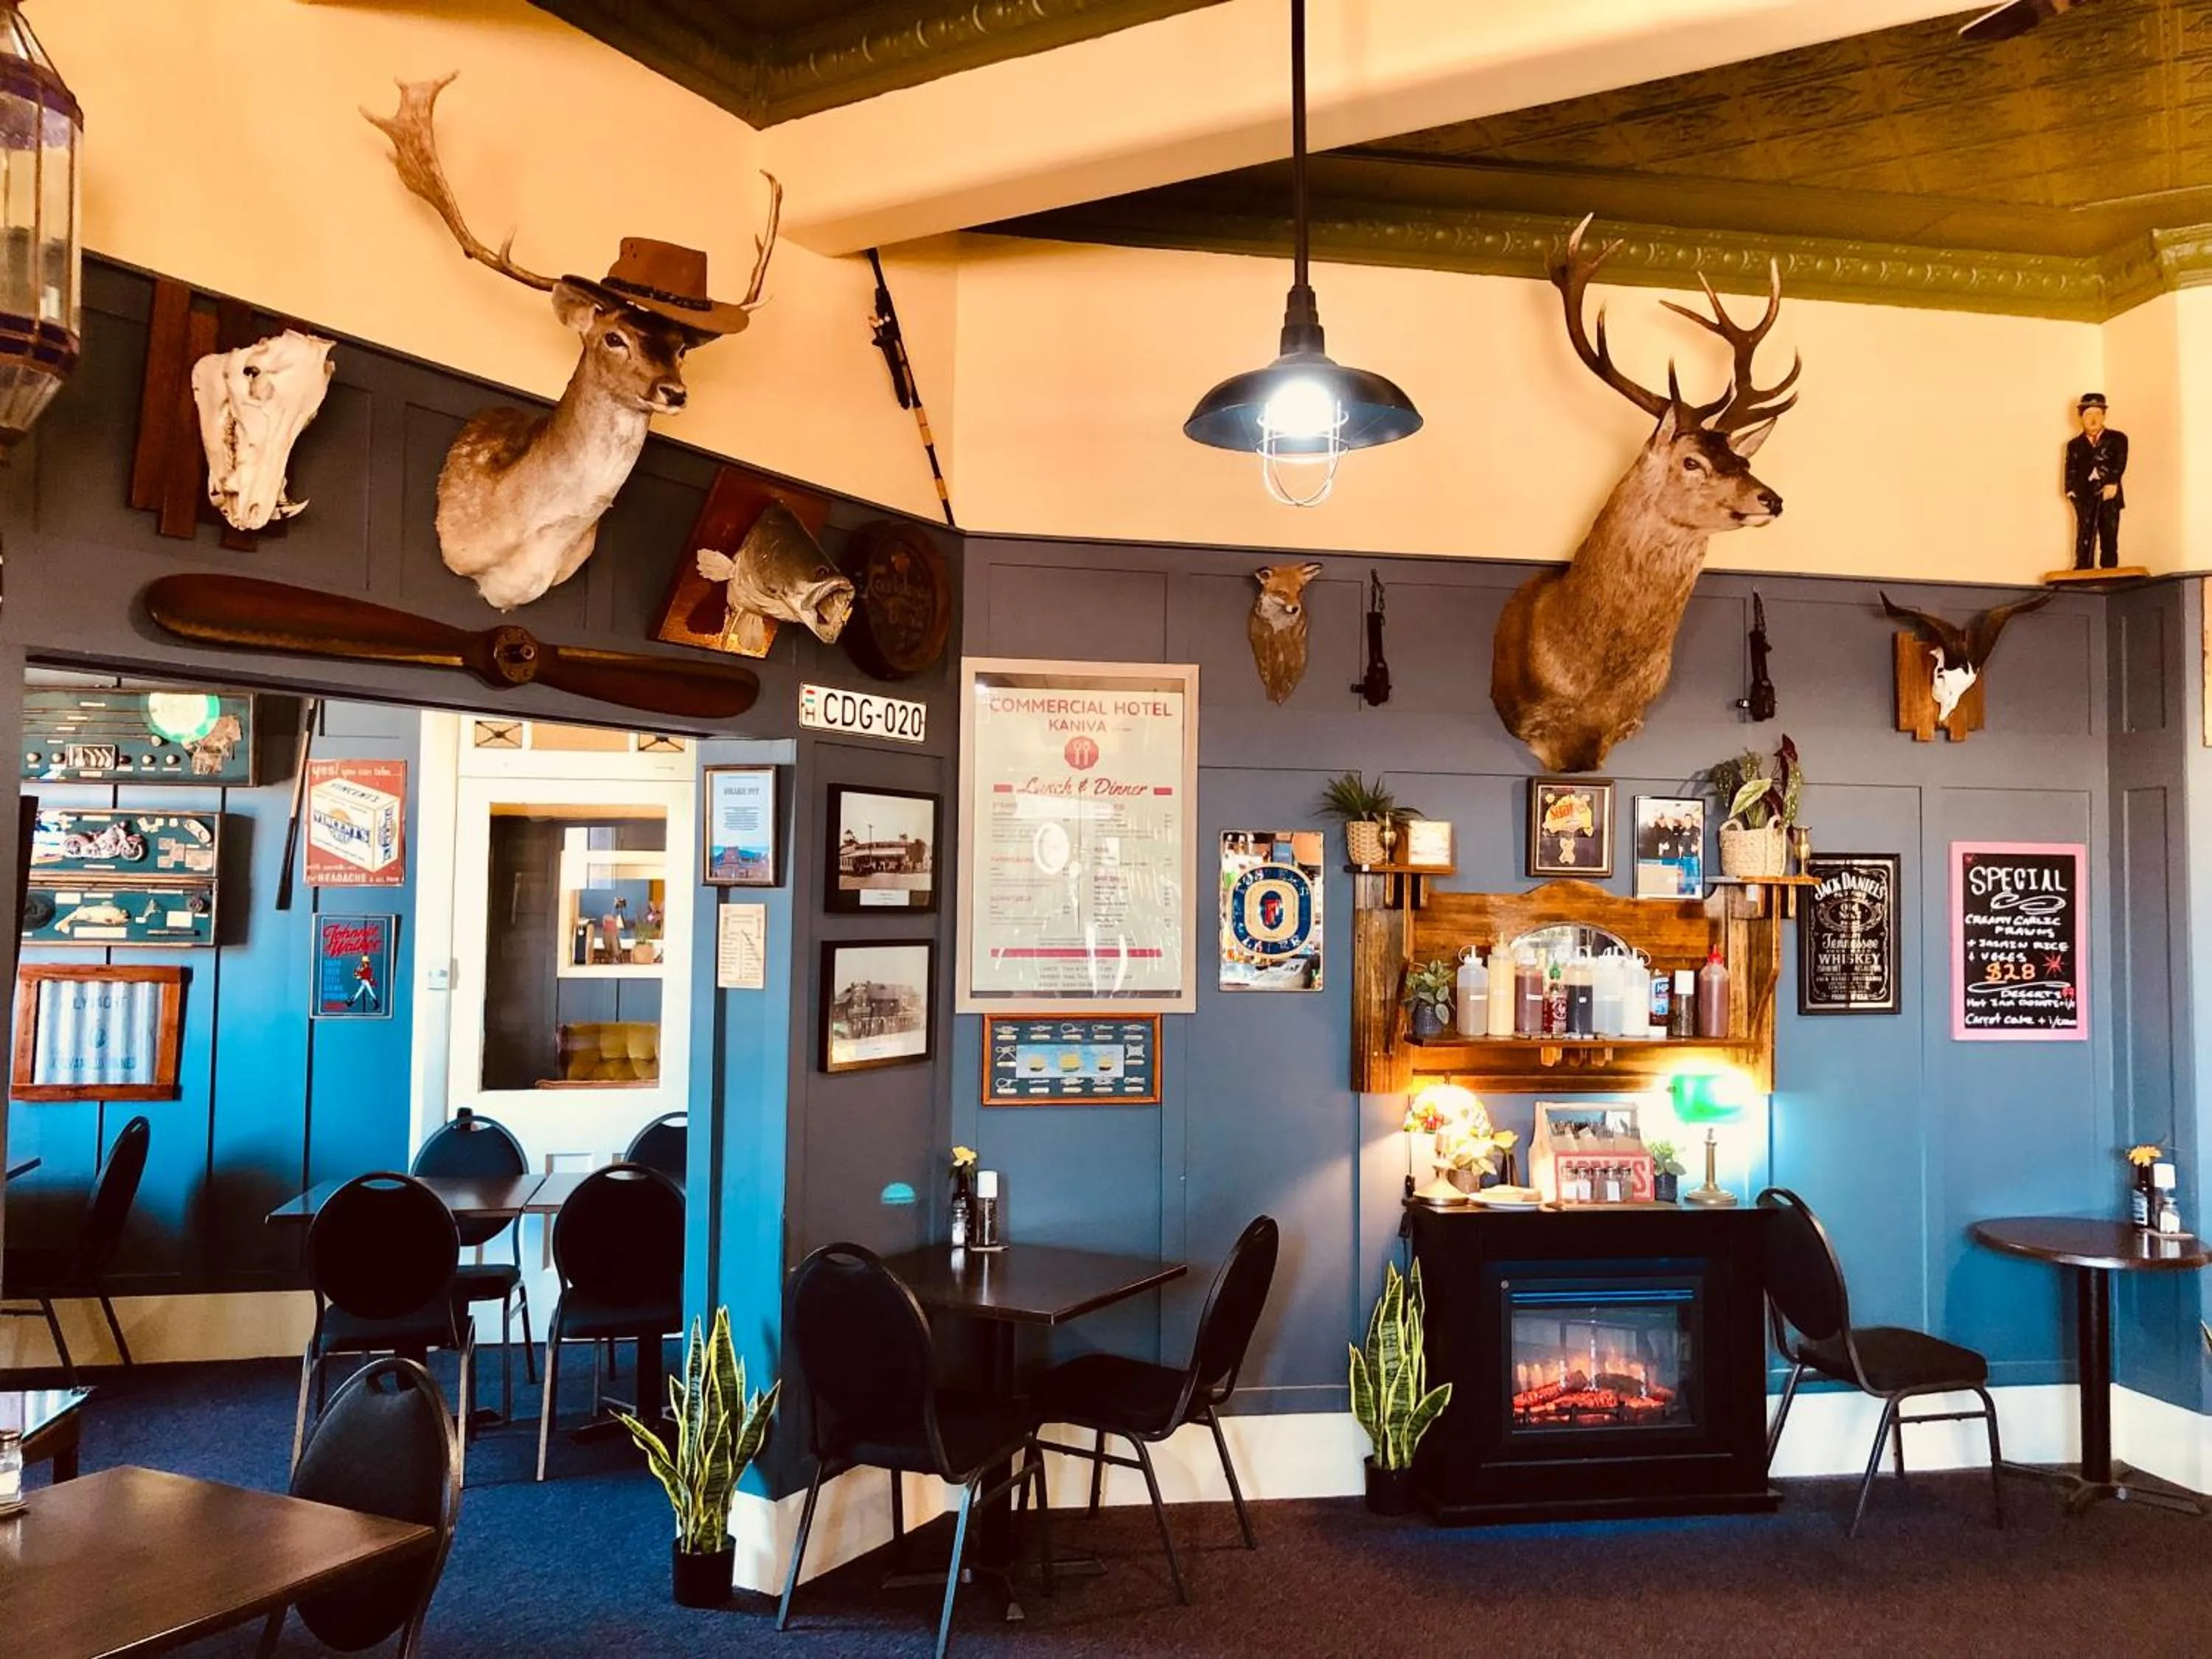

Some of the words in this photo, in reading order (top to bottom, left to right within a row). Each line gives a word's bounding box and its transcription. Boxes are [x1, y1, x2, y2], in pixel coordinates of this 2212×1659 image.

[824, 692, 922, 737] CDG-020
[990, 698, 1107, 715] COMMERCIAL
[1114, 701, 1173, 717] HOTEL
[1048, 718, 1107, 732] KANIVA
[1017, 776, 1073, 796] Lunch
[1077, 777, 1088, 793] &
[1093, 778, 1147, 796] Dinner
[1815, 877, 1842, 901] JACK
[1969, 866, 2067, 896] SPECIAL
[1965, 914, 2011, 925] CREAMY
[2013, 915, 2062, 926] GARLIC
[1822, 933, 1879, 950] Tennessee
[1994, 926, 2055, 939] PRAWNS
[2033, 941, 2069, 953] RICE
[1818, 953, 1881, 965] WHISKEY
[1984, 961, 2036, 982] $28
